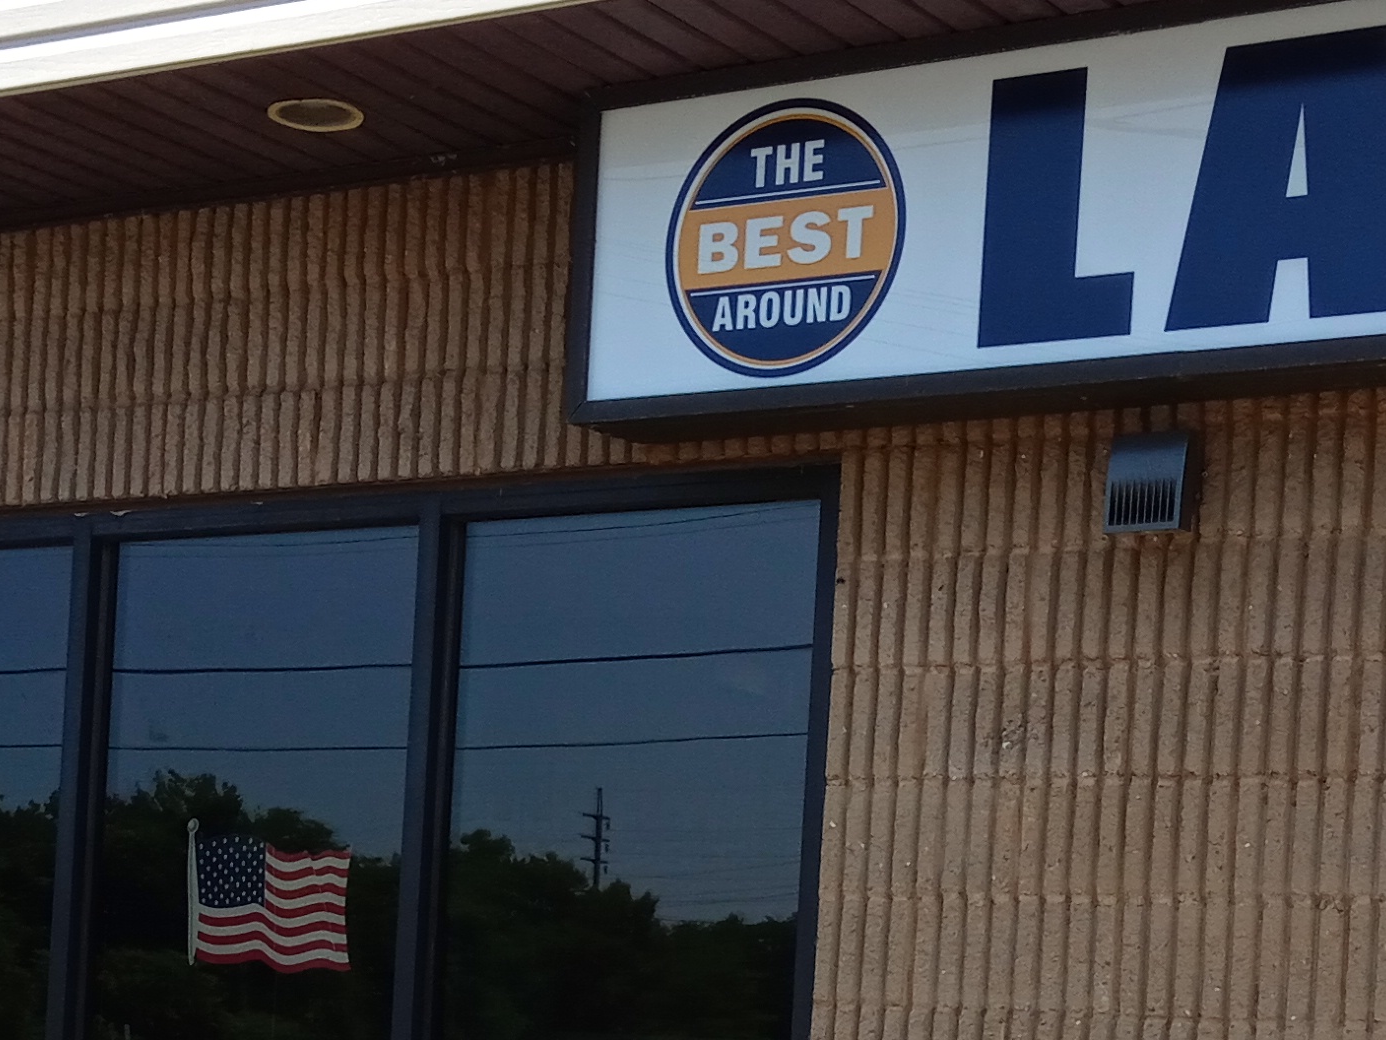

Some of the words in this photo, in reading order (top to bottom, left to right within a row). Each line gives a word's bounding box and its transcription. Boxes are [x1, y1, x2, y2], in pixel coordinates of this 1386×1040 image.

[750, 139, 825, 188] THE
[697, 205, 874, 275] BEST
[712, 285, 852, 332] AROUND
